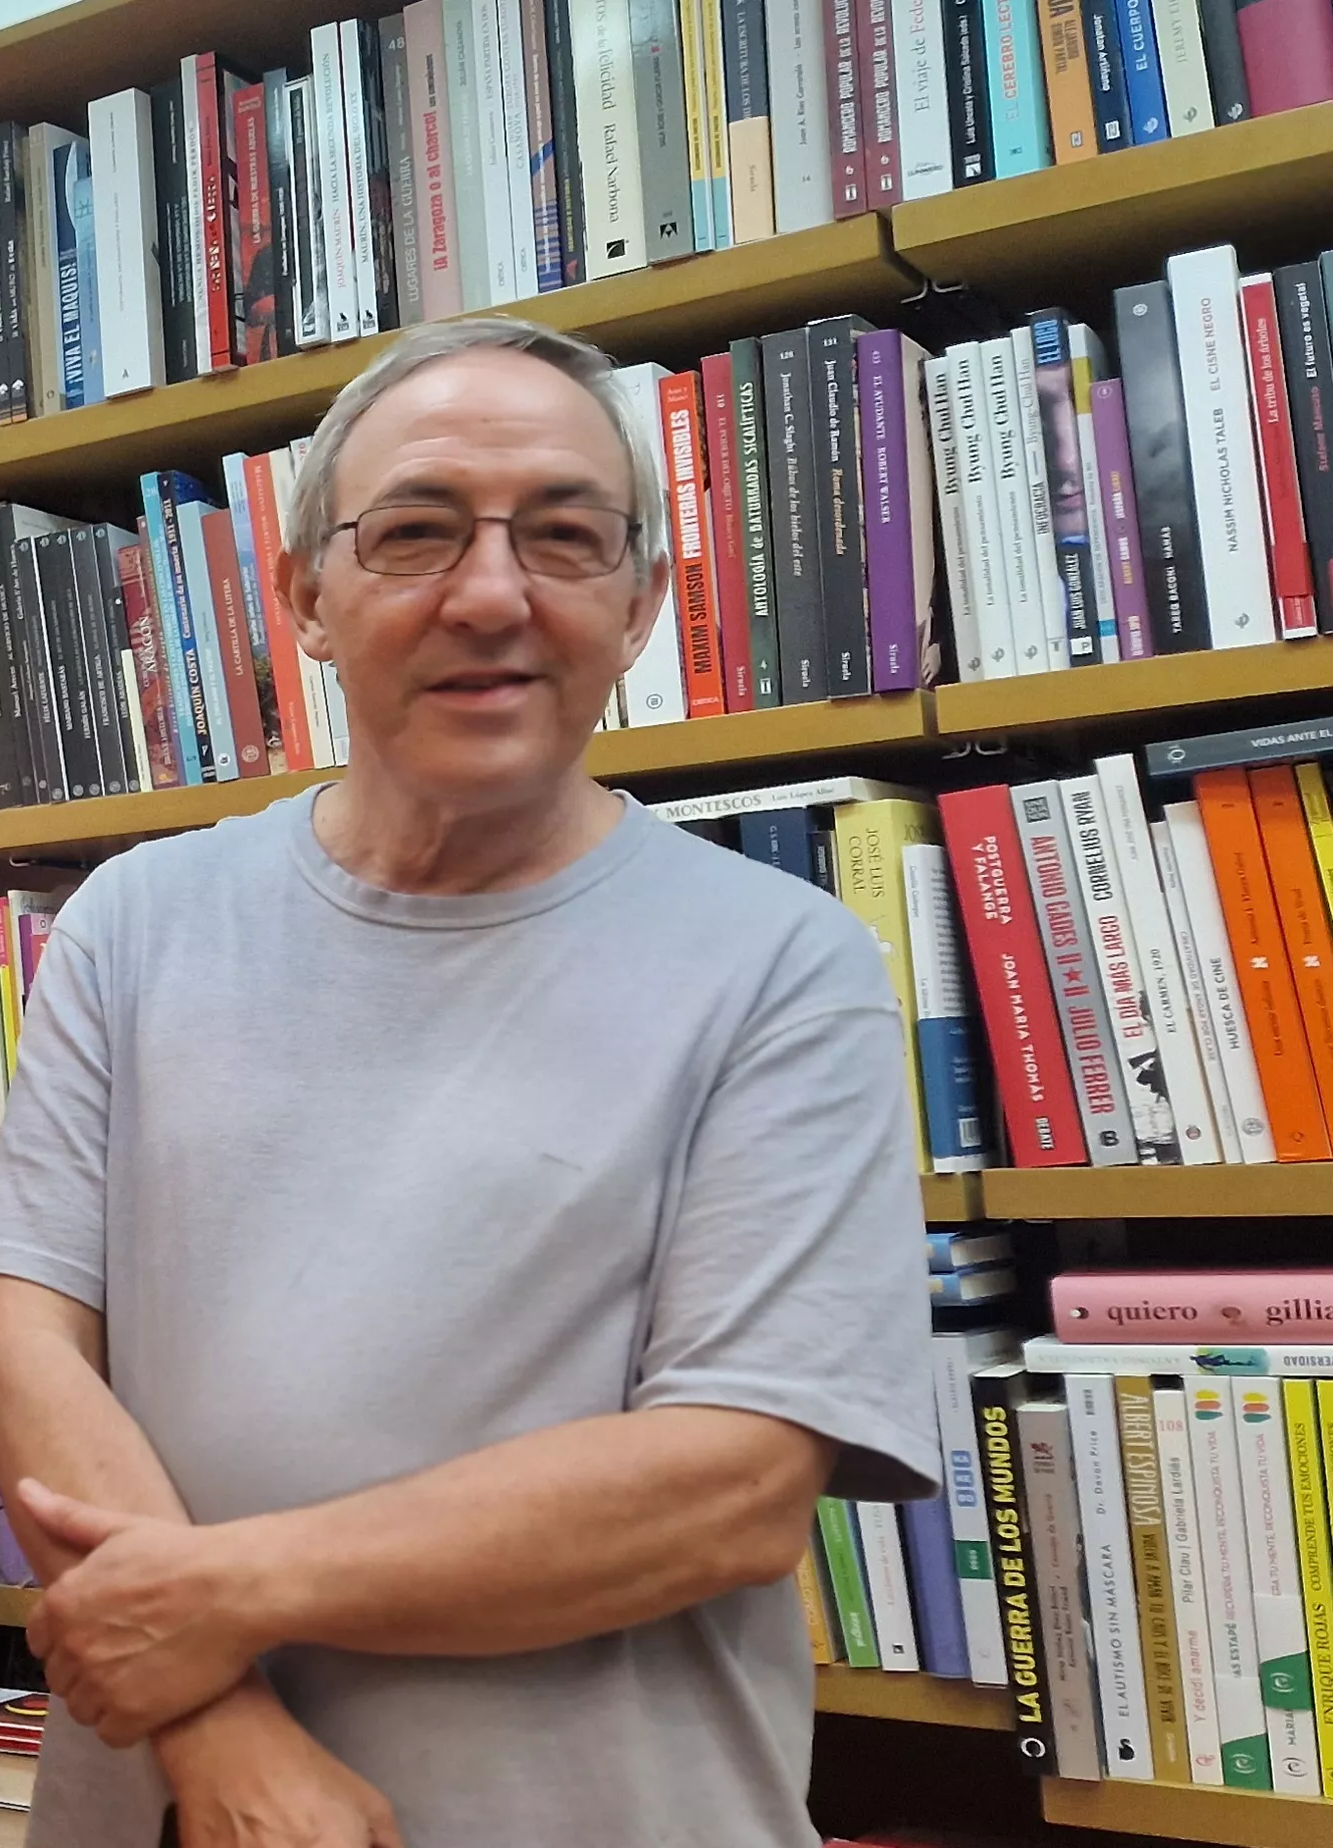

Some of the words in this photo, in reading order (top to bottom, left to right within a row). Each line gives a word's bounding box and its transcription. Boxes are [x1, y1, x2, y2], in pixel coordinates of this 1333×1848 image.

[838, 47, 852, 57] DE
[911, 38, 927, 55] de
[322, 53, 335, 114] REVOLUCIÓN
[839, 61, 854, 99] POPULAR
[912, 59, 929, 92] viaje
[1000, 34, 1017, 99] CEREBRO
[350, 105, 361, 134] SIGLO
[914, 95, 930, 112] El
[1005, 101, 1019, 120] EL
[325, 115, 338, 159] SEGUNDA
[352, 136, 362, 153] DEL
[841, 102, 857, 153] ROMANCERO
[328, 160, 338, 172] LA
[353, 155, 365, 199] HISTORIA
[399, 155, 413, 206] GUERRA
[329, 174, 340, 203] HACIA
[331, 207, 343, 246] MAURÍN
[356, 201, 366, 222] UNA
[402, 209, 414, 226] LA
[404, 229, 415, 245] DE
[334, 248, 346, 289] JOAQUÍN
[405, 247, 419, 303] LUGARES
[61, 262, 80, 321] MAQUIS!
[1295, 282, 1311, 319] vegetal
[65, 323, 81, 342] EL
[1202, 296, 1216, 338] NEGRO
[1299, 319, 1312, 333] es
[66, 345, 84, 385] ¡VIVA
[1205, 340, 1219, 373] CISNE
[1300, 333, 1316, 366] futuro
[932, 372, 951, 404] Han
[955, 358, 974, 391] Han
[989, 353, 1007, 387] Han
[1208, 375, 1220, 392] EL
[1304, 366, 1317, 378] El
[936, 404, 955, 443] Chul
[959, 392, 978, 430] Chul
[992, 388, 1011, 425] Chul
[670, 408, 695, 481] INVISIBLES
[1213, 407, 1228, 445] TALEB
[940, 445, 960, 496] Byung
[963, 433, 983, 484] Byung
[996, 428, 1016, 480] Byung
[1217, 445, 1234, 506] NICHOLAS
[745, 459, 763, 533] BATURRADAS
[676, 482, 702, 559] FRONTERAS
[1223, 508, 1238, 553] NASSIM
[749, 536, 764, 549] de
[222, 577, 235, 605] LITERA
[684, 562, 708, 621] SAMSON
[750, 552, 769, 617] ANTOLOGÍA
[226, 606, 236, 616] LA
[227, 616, 237, 626] DE
[137, 614, 158, 674] ARAGÓN
[228, 626, 242, 665] CARTILLA
[689, 623, 712, 675] MAXIM
[186, 647, 202, 684] COSTA
[233, 666, 244, 676] LA
[97, 681, 105, 690] DE
[98, 690, 109, 726] FRANCISCO
[190, 685, 207, 736] JOAQUÍN
[1251, 735, 1287, 749] VIDAS
[1288, 730, 1318, 744] ANTE
[1320, 729, 1333, 740] EL
[666, 795, 762, 820] MONTESCOS
[1071, 789, 1098, 827] RYAN
[848, 836, 867, 895] CORRAL
[973, 842, 987, 854] Y
[1031, 832, 1068, 899] ANTONIO
[1078, 825, 1111, 903] CORNELIUS
[975, 855, 997, 921] FALANGE
[986, 834, 1012, 925] POSTGUERRA
[1210, 956, 1226, 983] CINE
[1216, 985, 1230, 1001] DE
[1067, 1004, 1100, 1053] JULIO
[1220, 1002, 1240, 1051] HUESCA
[1077, 1050, 1114, 1117] FERRER
[1107, 1300, 1199, 1326] quiero
[983, 1404, 1017, 1503] MUNDOS
[1294, 1422, 1313, 1492] EMOCIONES
[1300, 1493, 1315, 1516] TUS
[995, 1507, 1023, 1552] LOS
[1001, 1557, 1027, 1587] DE
[1303, 1517, 1322, 1592] COMPRENDE
[1005, 1591, 1038, 1687] GUERRA
[1311, 1602, 1330, 1650] ROJAS
[1016, 1690, 1042, 1723] LA
[1315, 1651, 1333, 1725] ENRIQUE
